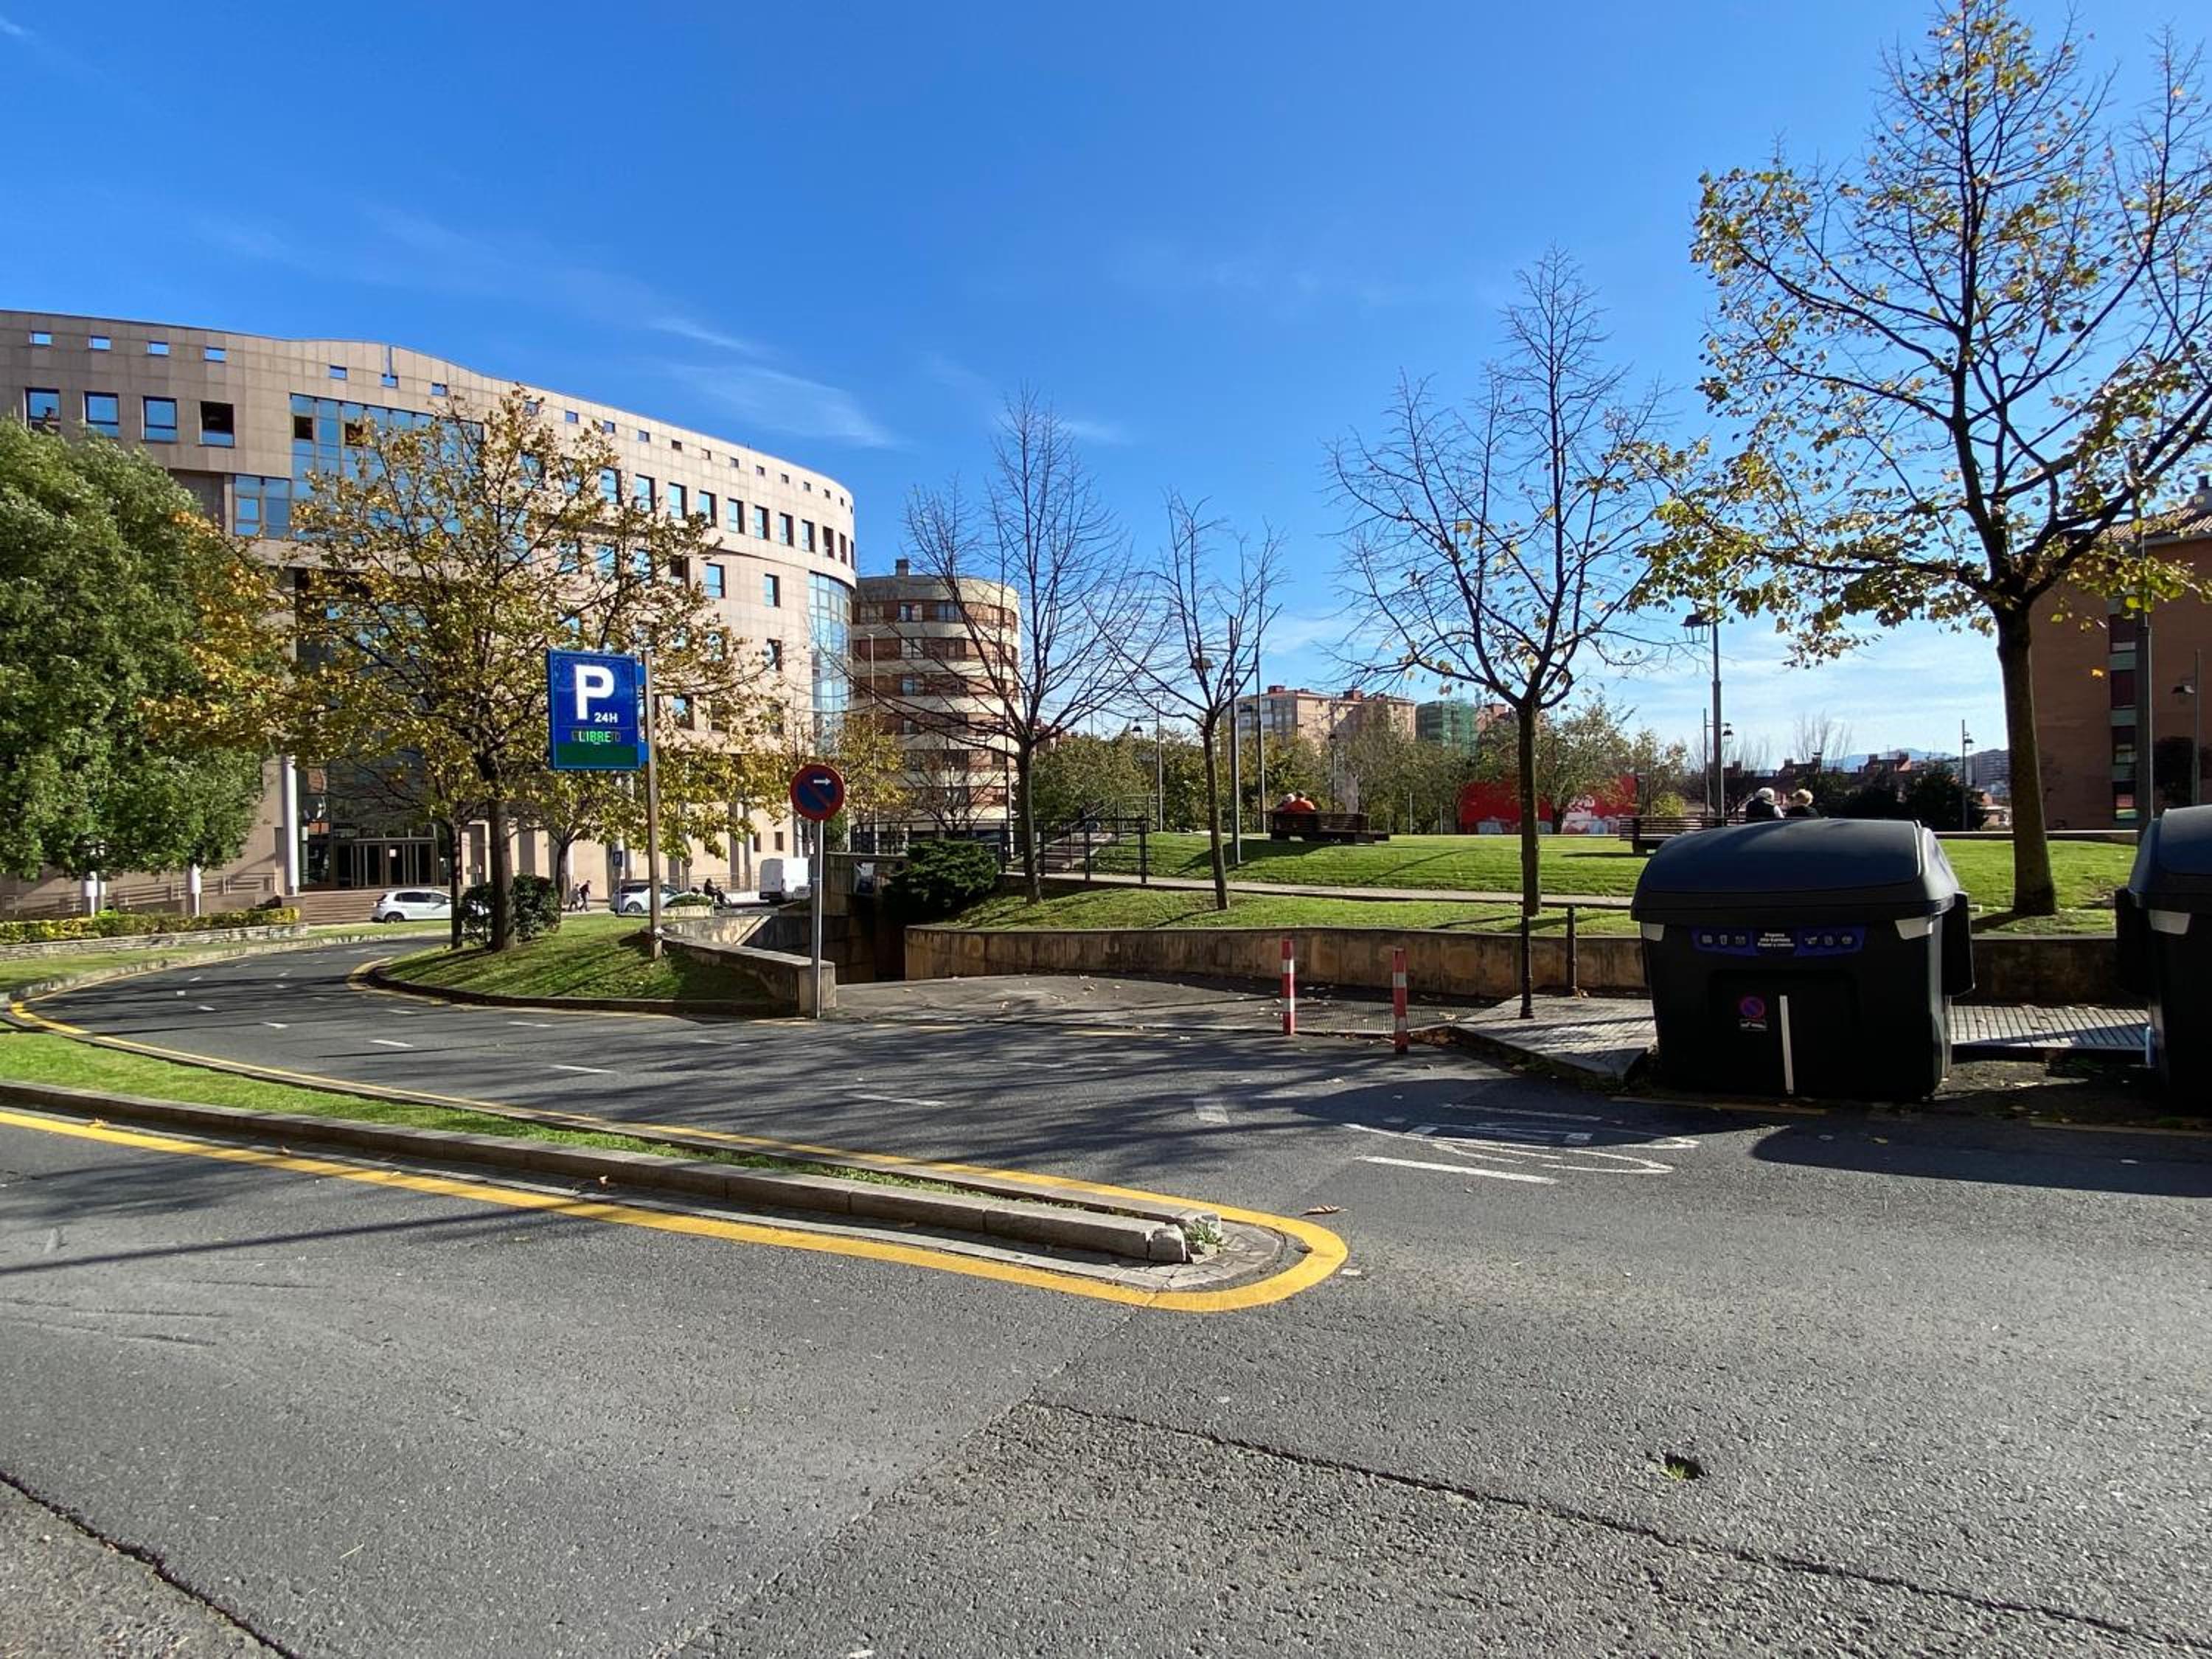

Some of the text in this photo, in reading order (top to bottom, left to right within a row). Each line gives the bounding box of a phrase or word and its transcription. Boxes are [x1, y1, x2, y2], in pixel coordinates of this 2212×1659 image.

[574, 664, 614, 720] P
[594, 712, 619, 723] 24H
[579, 731, 611, 742] LIBRE
